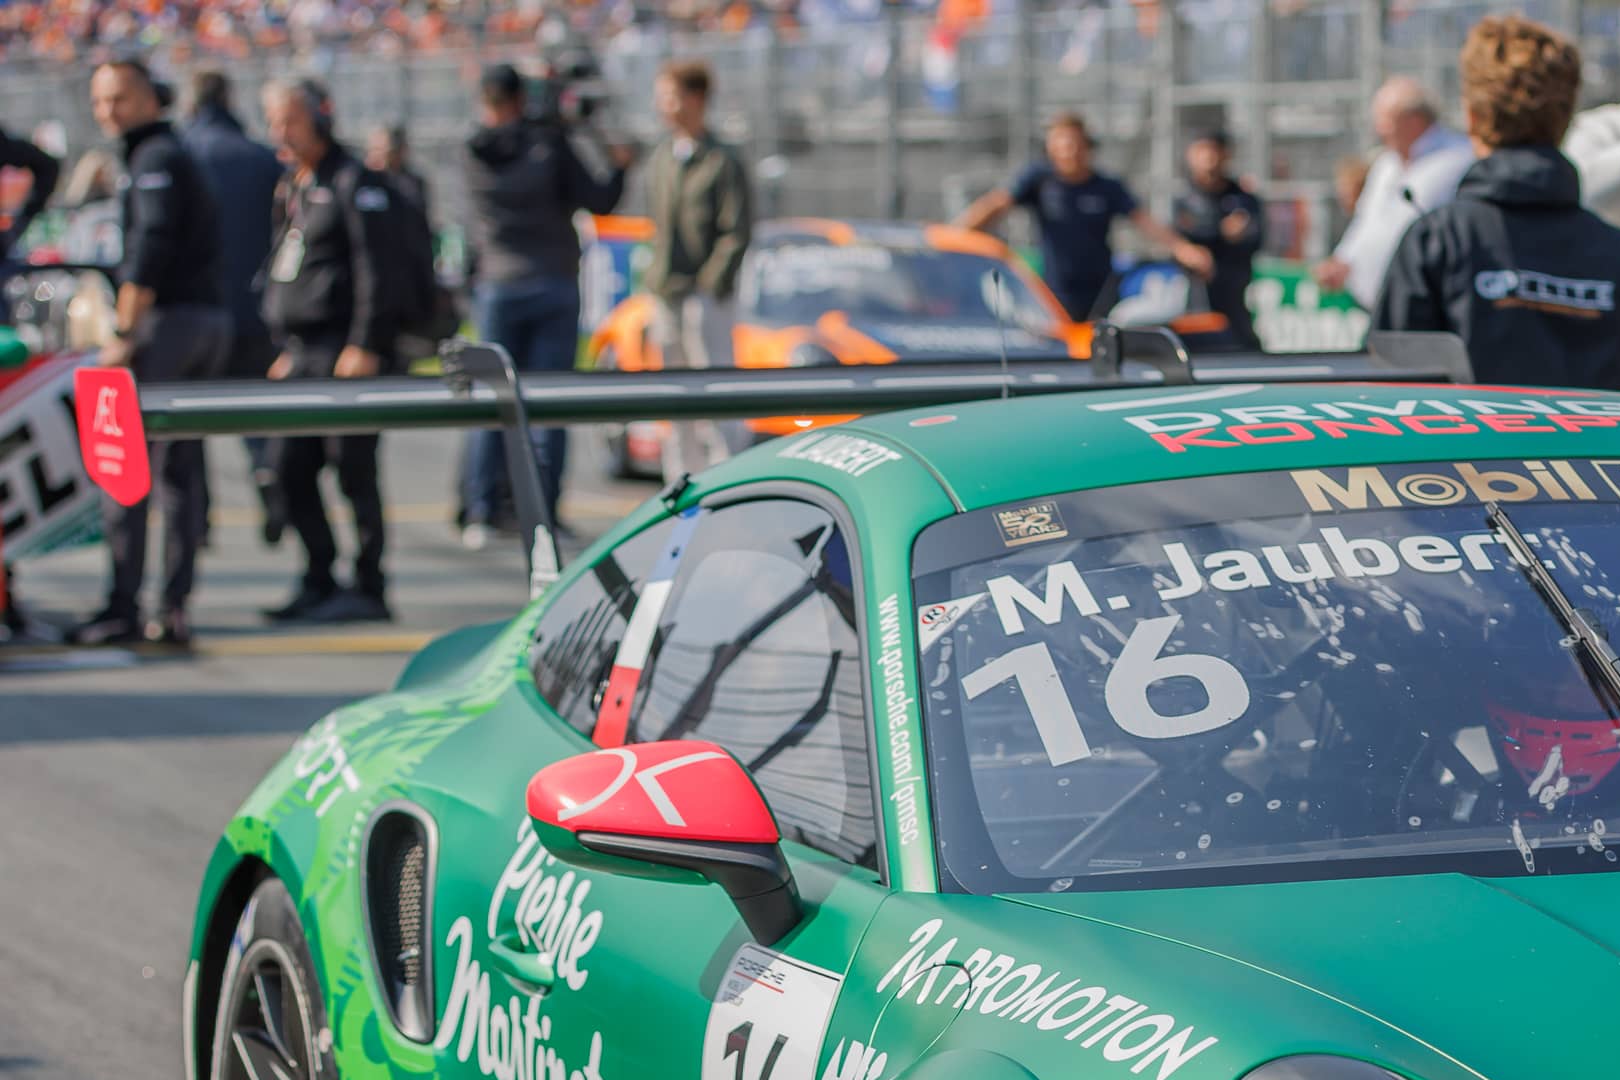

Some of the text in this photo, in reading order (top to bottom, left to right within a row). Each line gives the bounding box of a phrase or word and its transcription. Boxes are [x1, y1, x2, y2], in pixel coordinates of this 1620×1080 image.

[1290, 460, 1598, 512] Mobil
[986, 560, 1130, 636] M.
[877, 593, 922, 846] www.porsche.com/pmsc
[960, 613, 1251, 768] 16
[487, 815, 602, 990] Pierre
